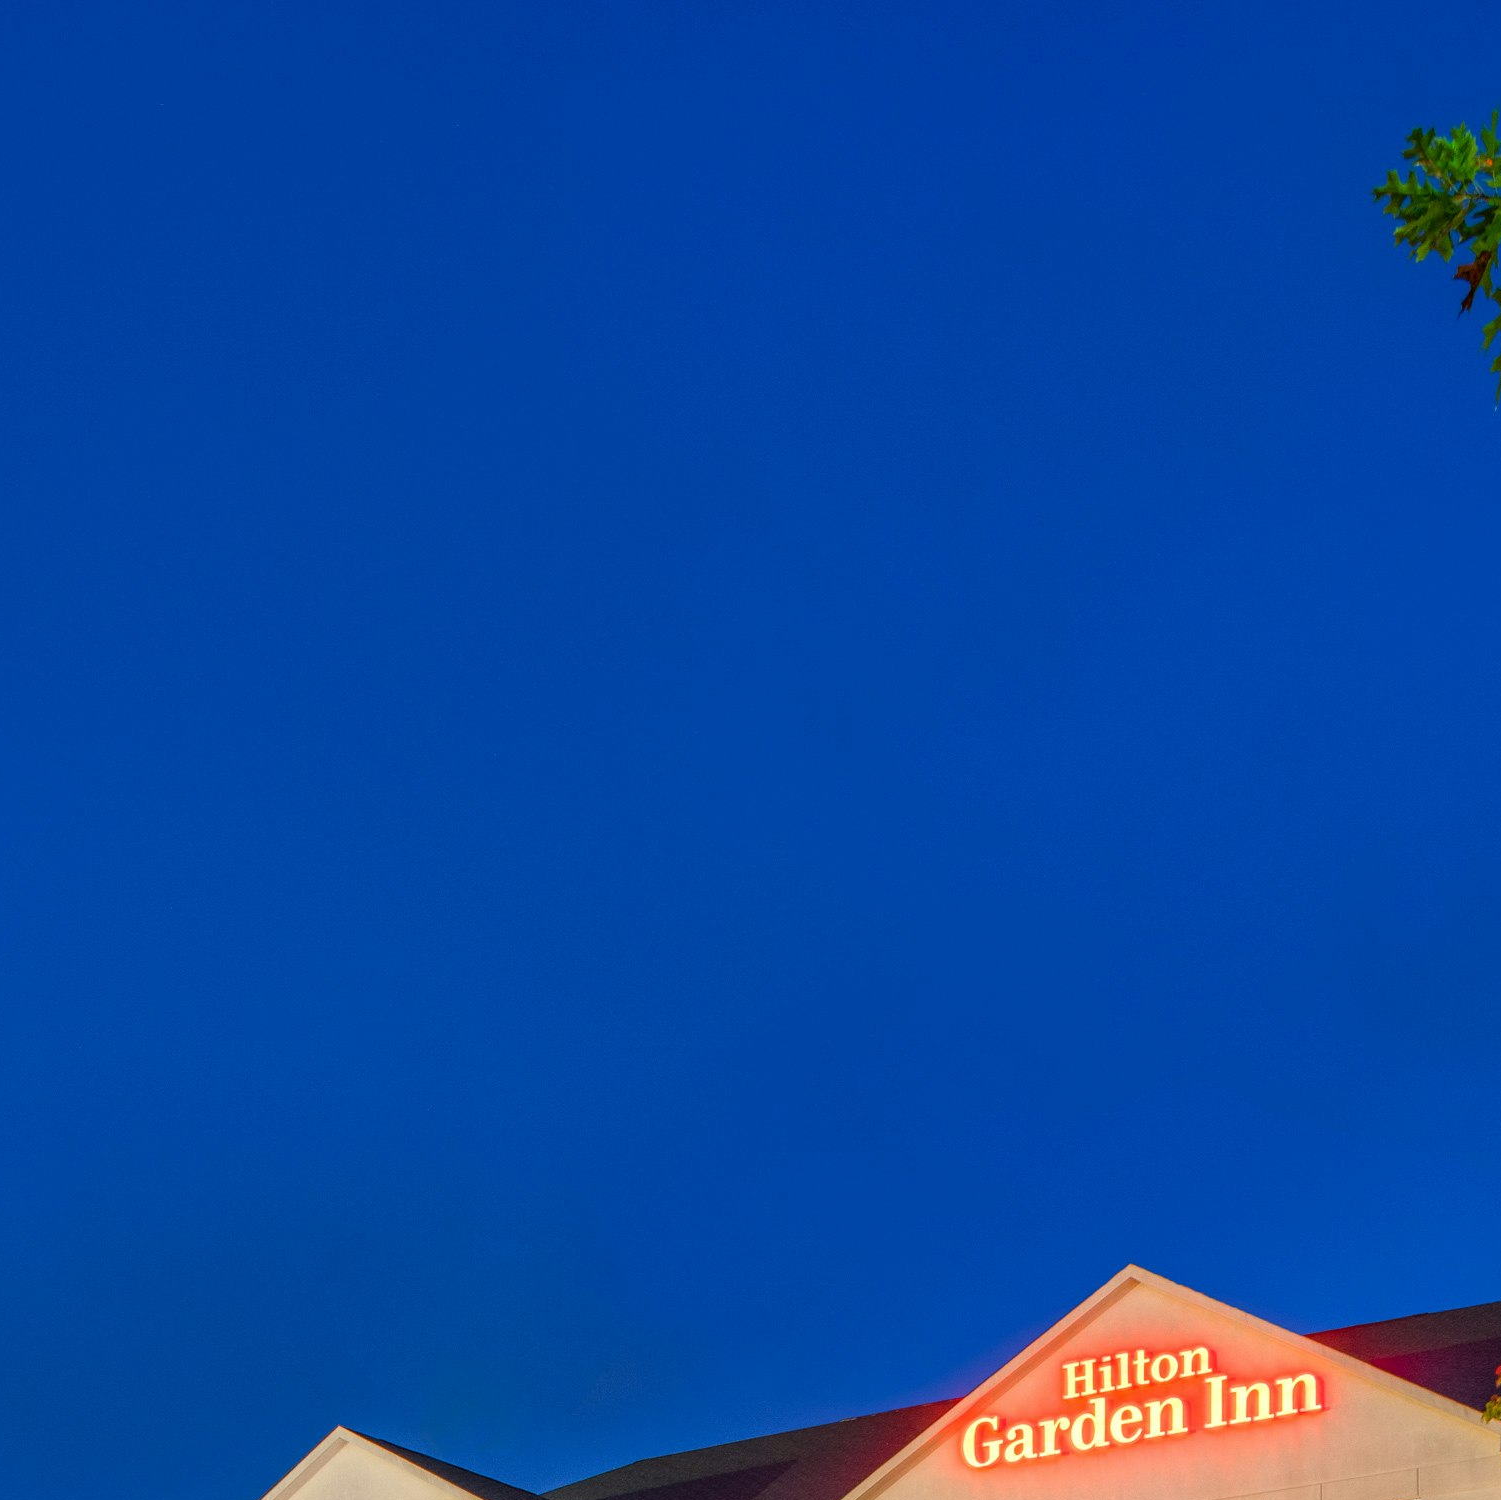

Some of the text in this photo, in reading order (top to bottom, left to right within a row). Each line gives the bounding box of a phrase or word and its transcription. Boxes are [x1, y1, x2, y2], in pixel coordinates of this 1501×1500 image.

[1062, 1347, 1213, 1399] Hilton
[962, 1372, 1322, 1469] Garden Inn
